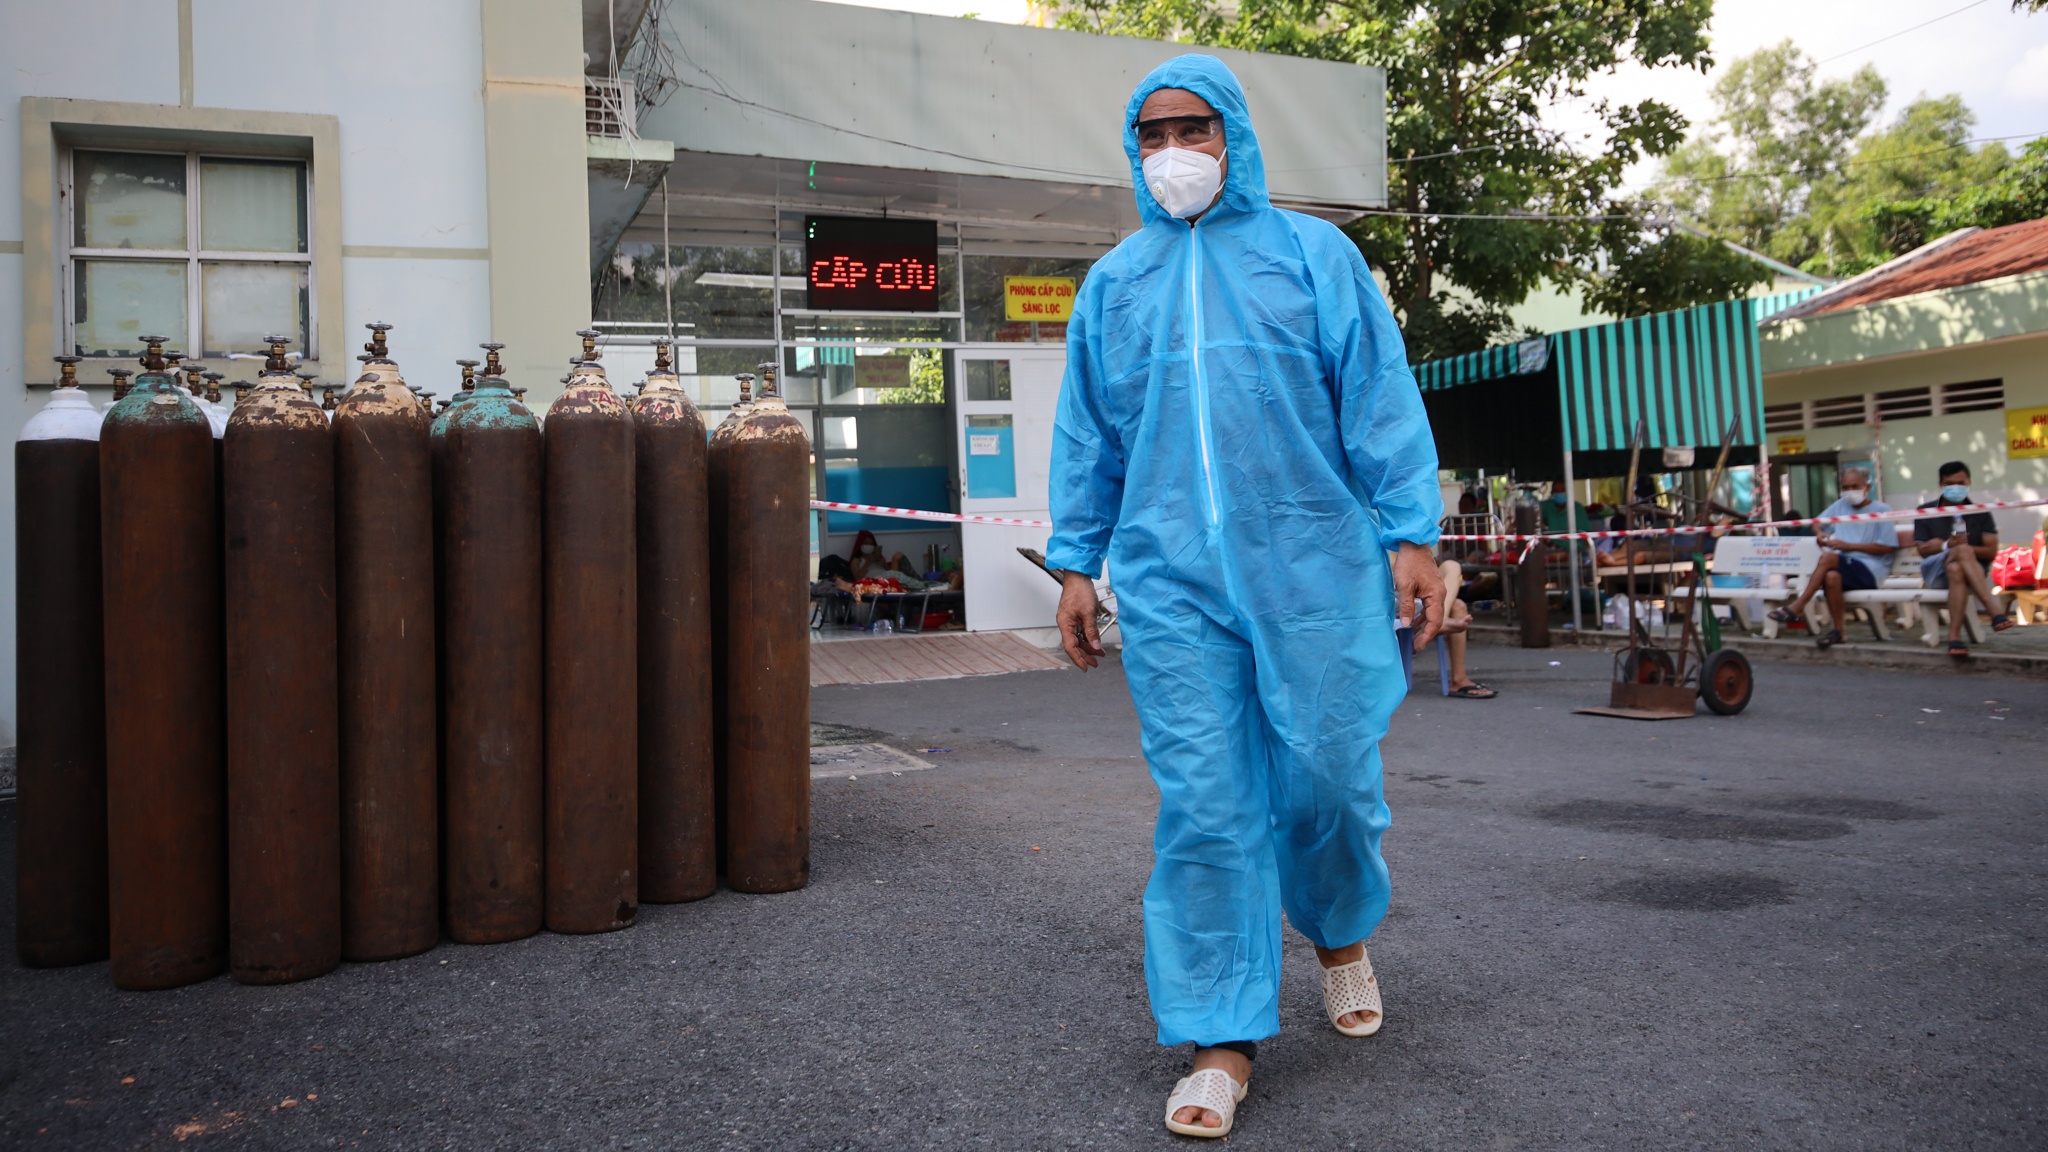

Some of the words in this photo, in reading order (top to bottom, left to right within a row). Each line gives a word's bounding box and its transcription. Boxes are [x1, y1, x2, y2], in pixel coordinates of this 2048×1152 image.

[1009, 283, 1036, 296] PHÒNG
[1038, 282, 1054, 297] CẤP
[1056, 283, 1072, 298] CỨU
[1022, 300, 1043, 314] SÀNG
[1045, 303, 1061, 316] LỌC
